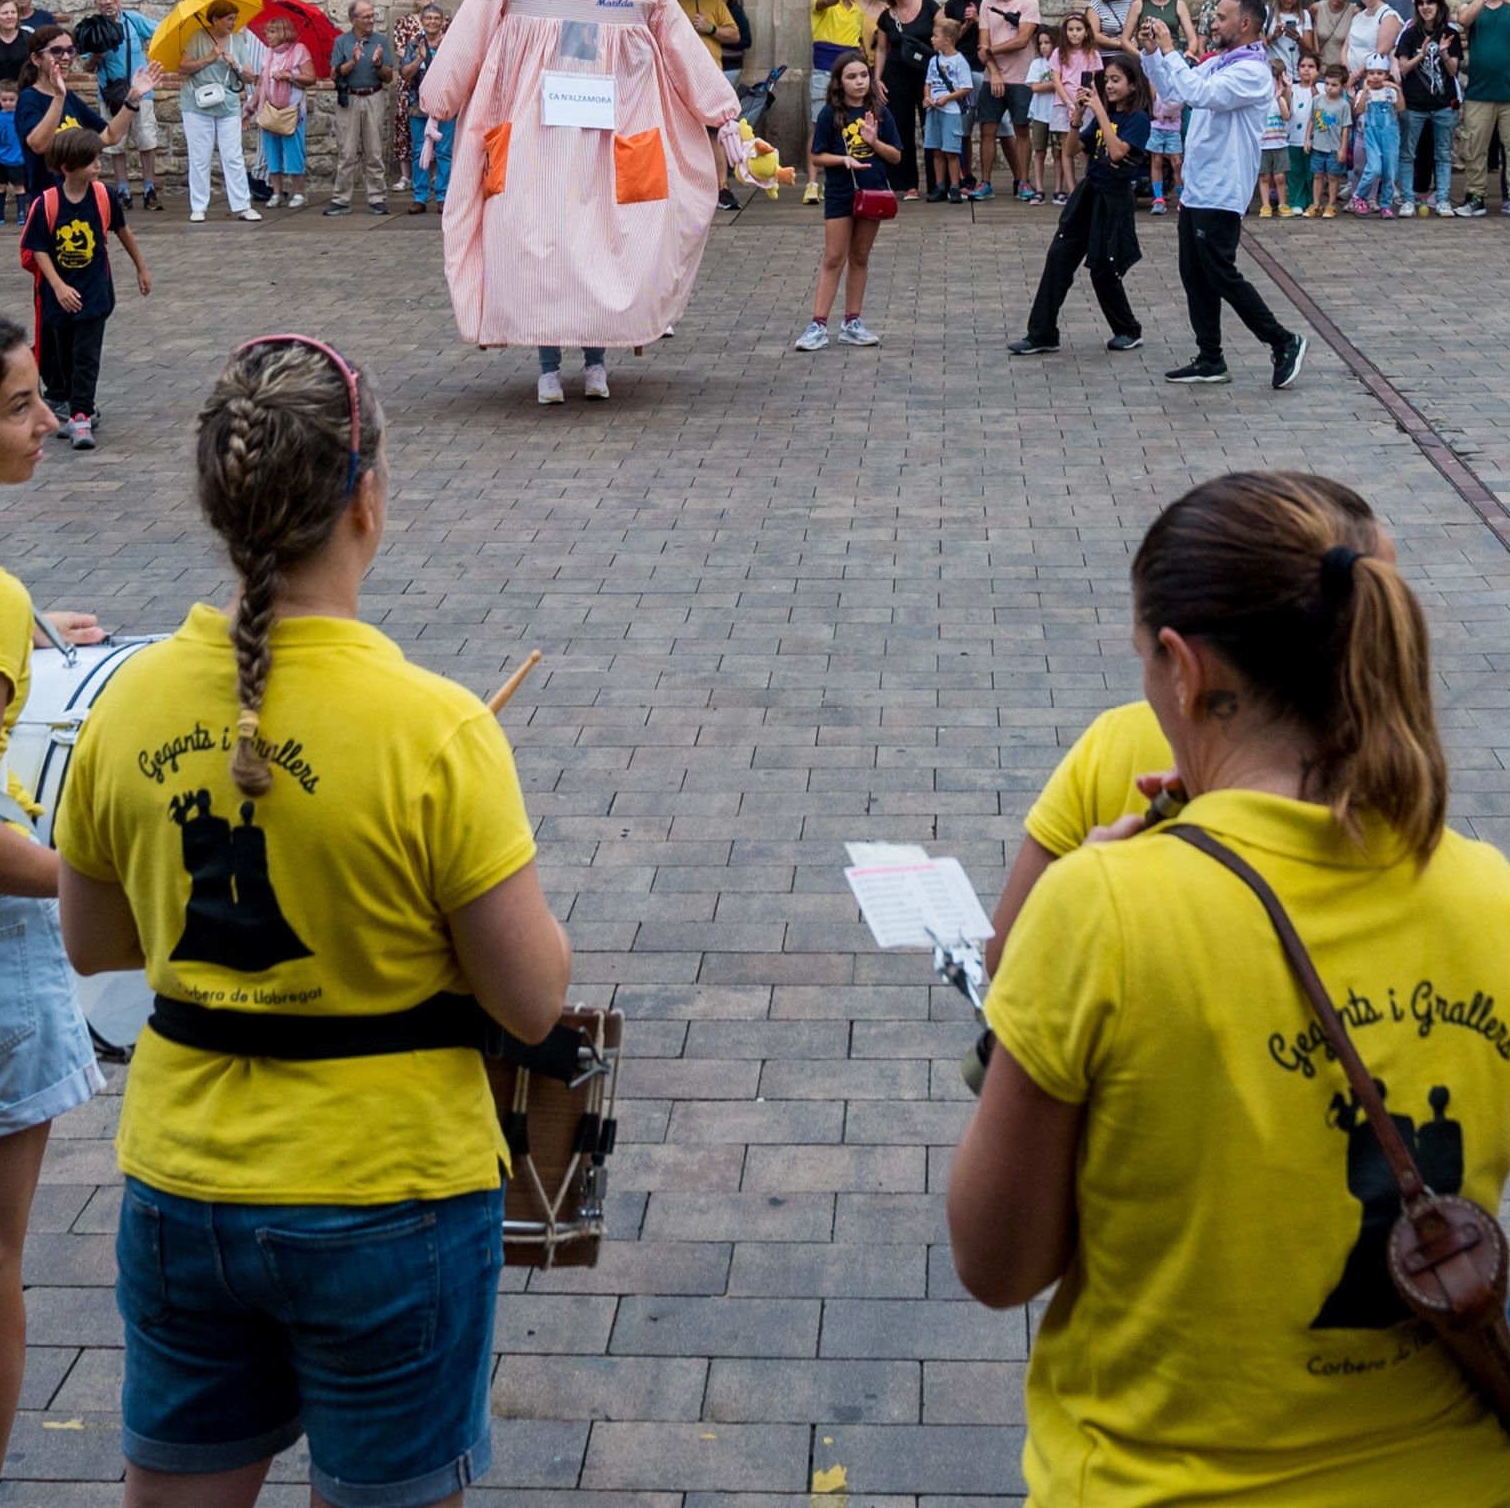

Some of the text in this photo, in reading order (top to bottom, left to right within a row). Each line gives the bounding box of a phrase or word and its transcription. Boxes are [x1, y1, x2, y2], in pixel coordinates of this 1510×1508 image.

[549, 92, 613, 104] CA N'ALZAMORA
[138, 721, 320, 795] Gegants i rallers
[230, 986, 248, 1003] de
[253, 986, 323, 1005] Llobregat
[1268, 987, 1384, 1079] Gegnts
[1388, 987, 1405, 1022] i
[1306, 1355, 1387, 1376] Corbera
